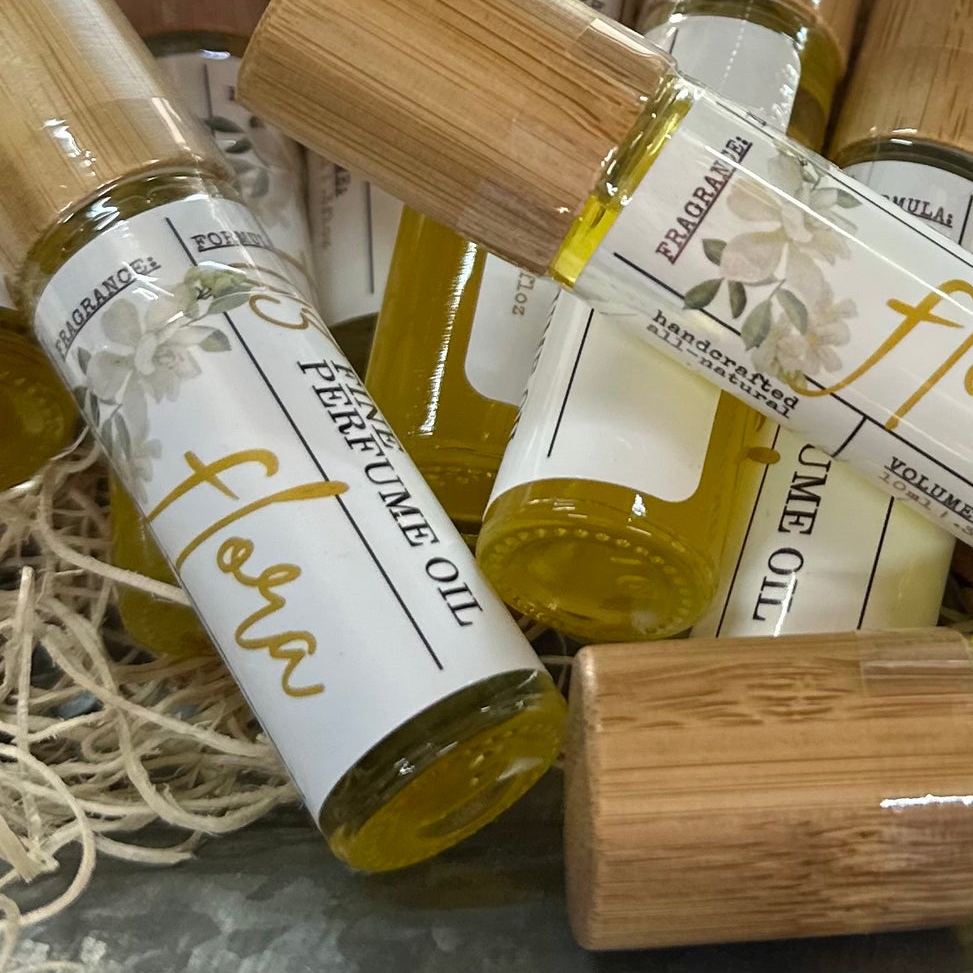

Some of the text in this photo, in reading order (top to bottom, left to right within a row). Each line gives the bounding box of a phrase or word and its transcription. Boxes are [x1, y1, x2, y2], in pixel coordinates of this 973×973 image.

[655, 136, 753, 265] FRAGRANCE:
[55, 256, 162, 362] FRAGRANCE:
[652, 309, 800, 411] handcrafted
[331, 359, 405, 453] FINE
[646, 323, 791, 420] all-natural
[296, 359, 441, 548] PERFUME
[424, 556, 484, 627] OIL
[878, 471, 932, 512] 10ml
[147, 448, 350, 698] flora
[752, 546, 805, 622] OIL
